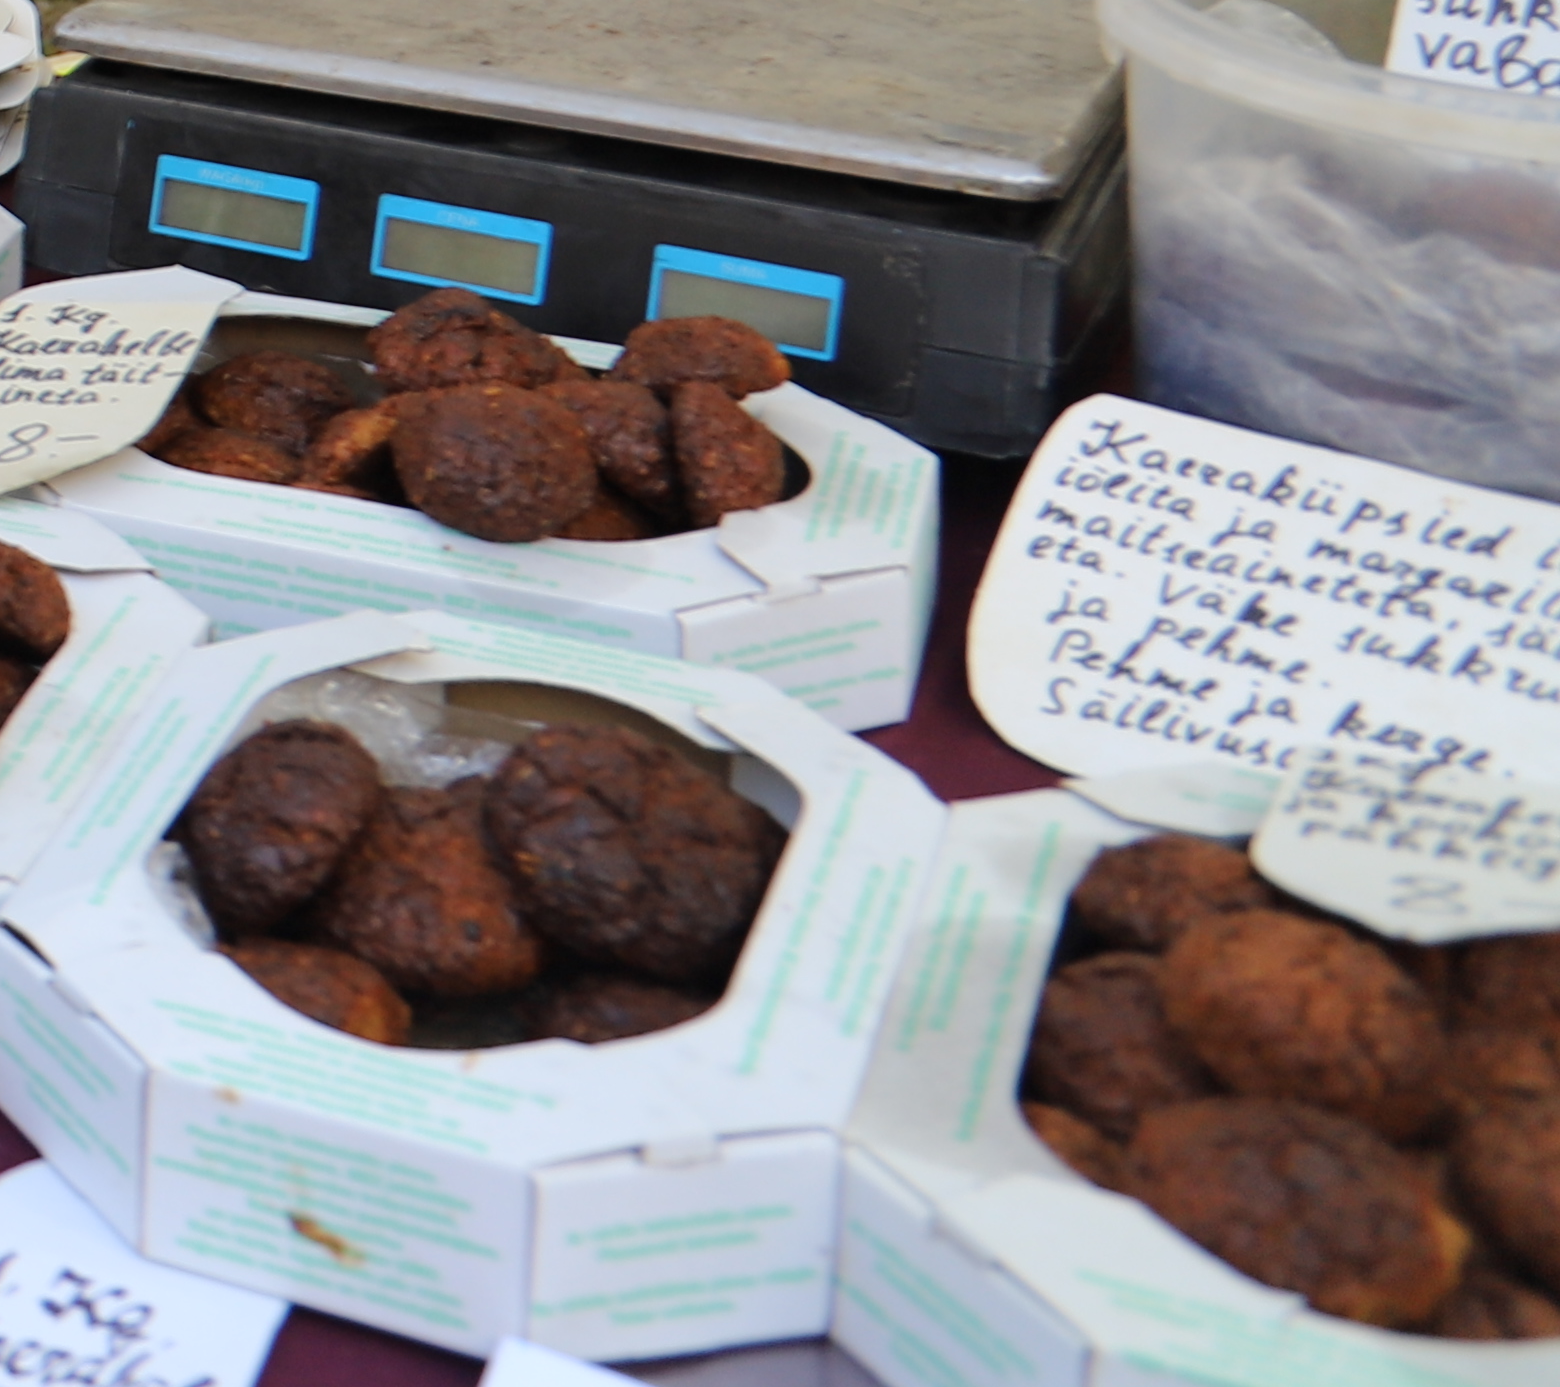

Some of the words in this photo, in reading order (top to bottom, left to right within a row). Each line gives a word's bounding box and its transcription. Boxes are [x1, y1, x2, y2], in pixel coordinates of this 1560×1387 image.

[1025, 533, 1127, 579] eta.
[1209, 504, 1278, 548] ja
[1045, 580, 1112, 625] ja
[1144, 613, 1334, 692] pehme.
[1048, 627, 1222, 703] Pehme
[1228, 681, 1299, 726] ja
